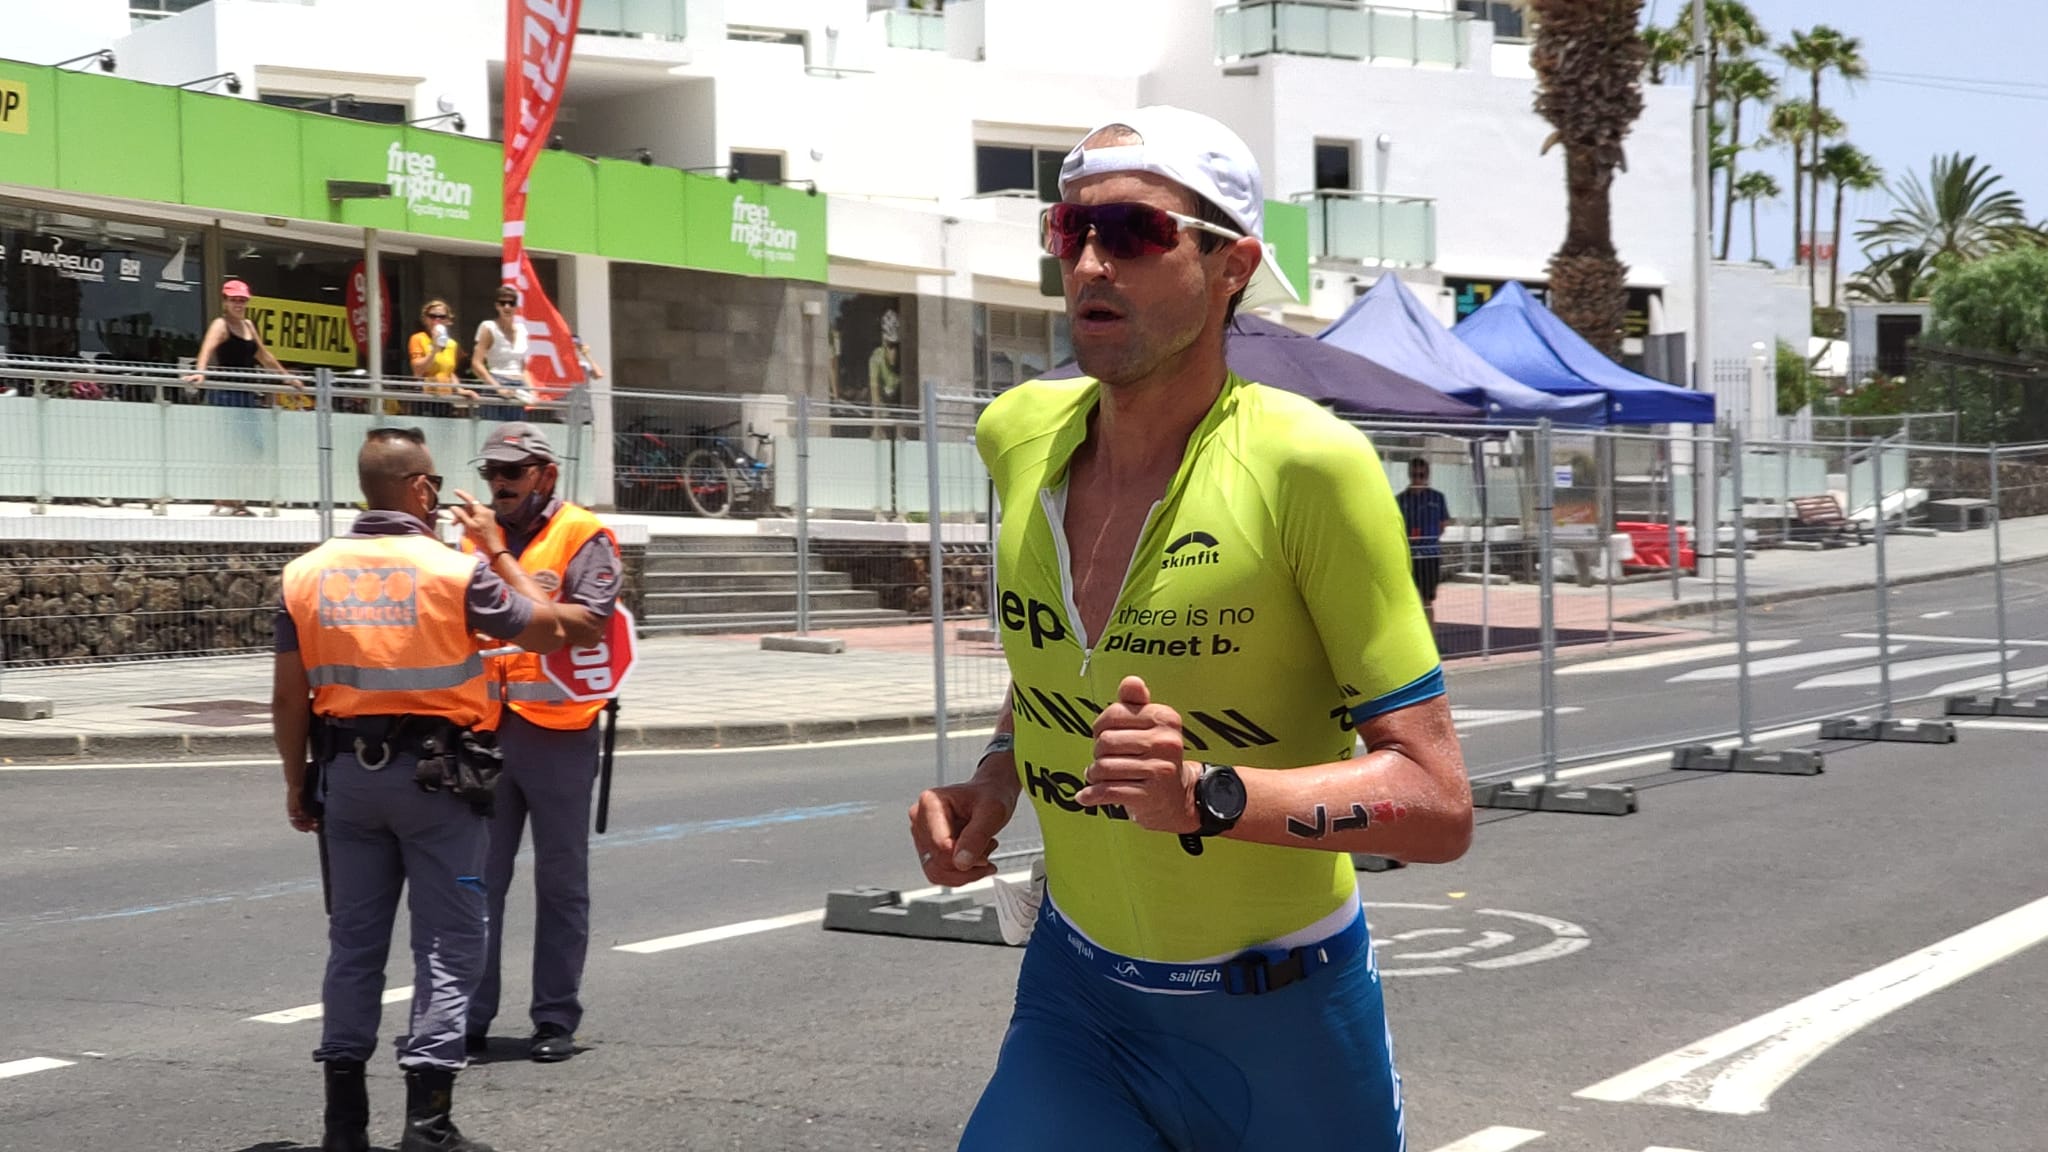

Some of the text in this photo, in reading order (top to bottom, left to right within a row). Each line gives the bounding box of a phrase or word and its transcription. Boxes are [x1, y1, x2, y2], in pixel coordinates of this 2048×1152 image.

[387, 142, 436, 176] free
[731, 194, 769, 226] free
[21, 249, 105, 273] PINARELLO
[280, 310, 350, 353] RENTAL
[1161, 550, 1219, 569] skinfit
[997, 583, 1066, 649] ep
[1118, 604, 1254, 626] there is no
[1104, 632, 1240, 656] planet b.
[1168, 969, 1221, 987] sailfish
